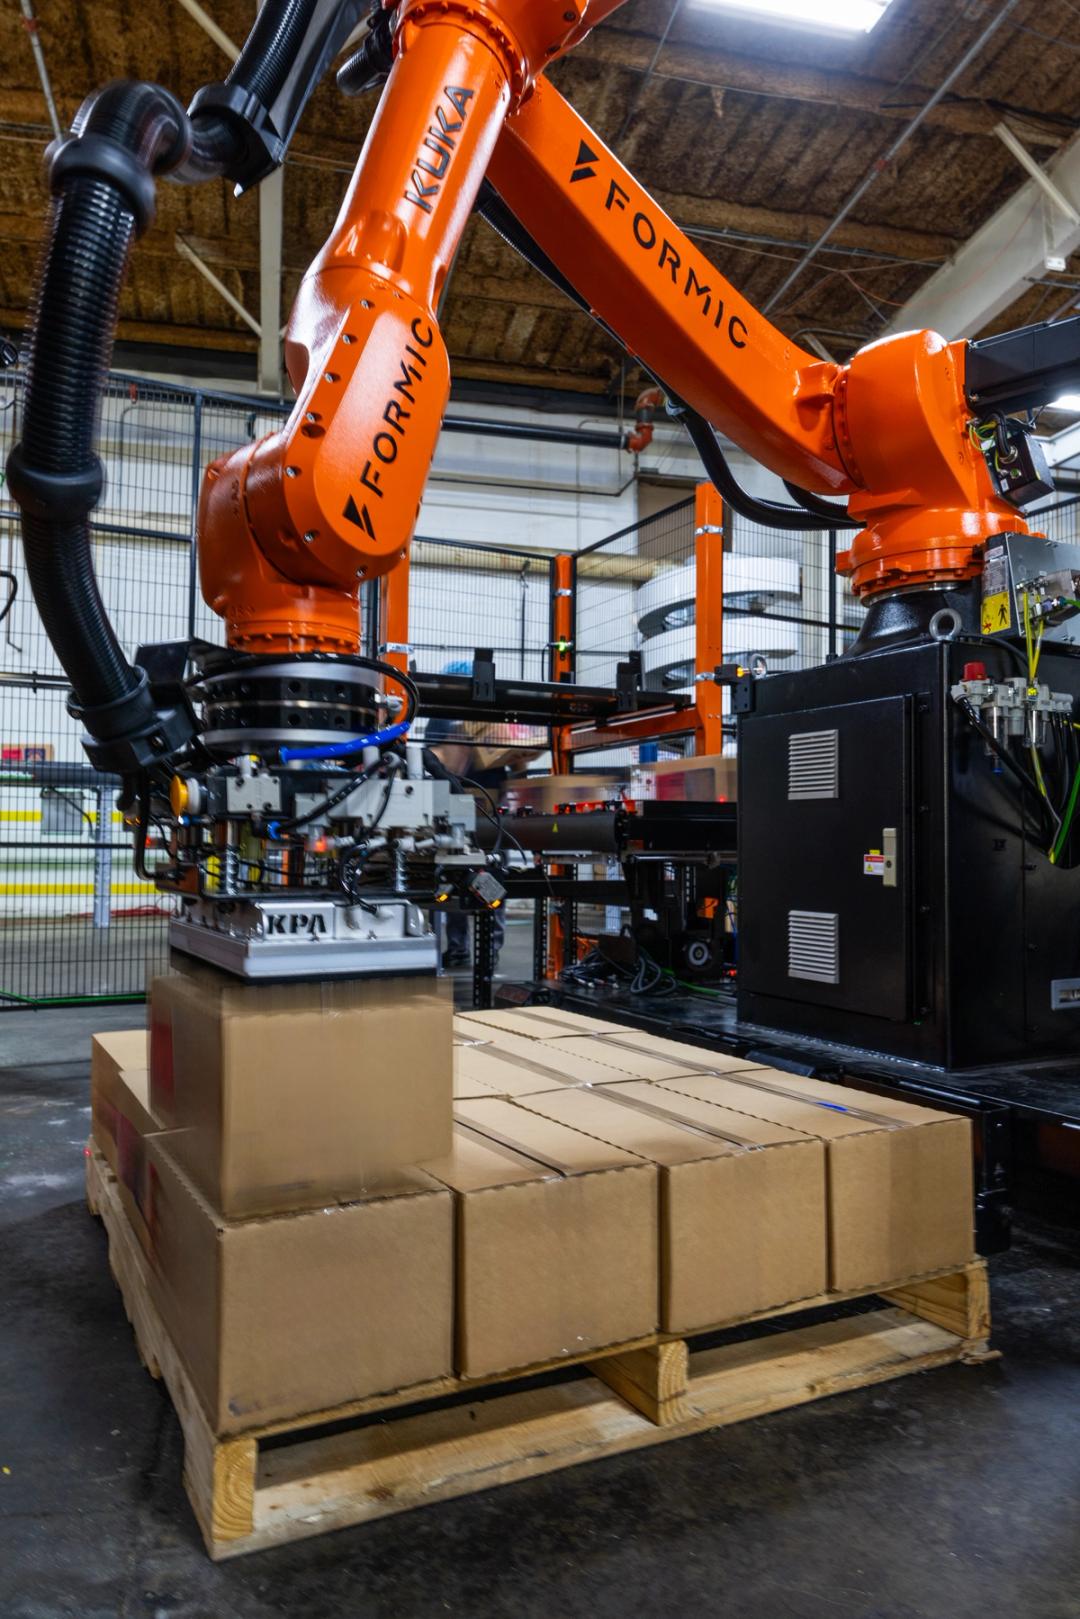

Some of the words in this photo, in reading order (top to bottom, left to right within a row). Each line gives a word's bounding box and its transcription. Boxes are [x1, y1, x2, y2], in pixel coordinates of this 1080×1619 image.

[404, 86, 474, 214] KUKA
[605, 179, 748, 349] FORMIC
[359, 317, 434, 498] FORMIC
[267, 913, 327, 935] KPA
